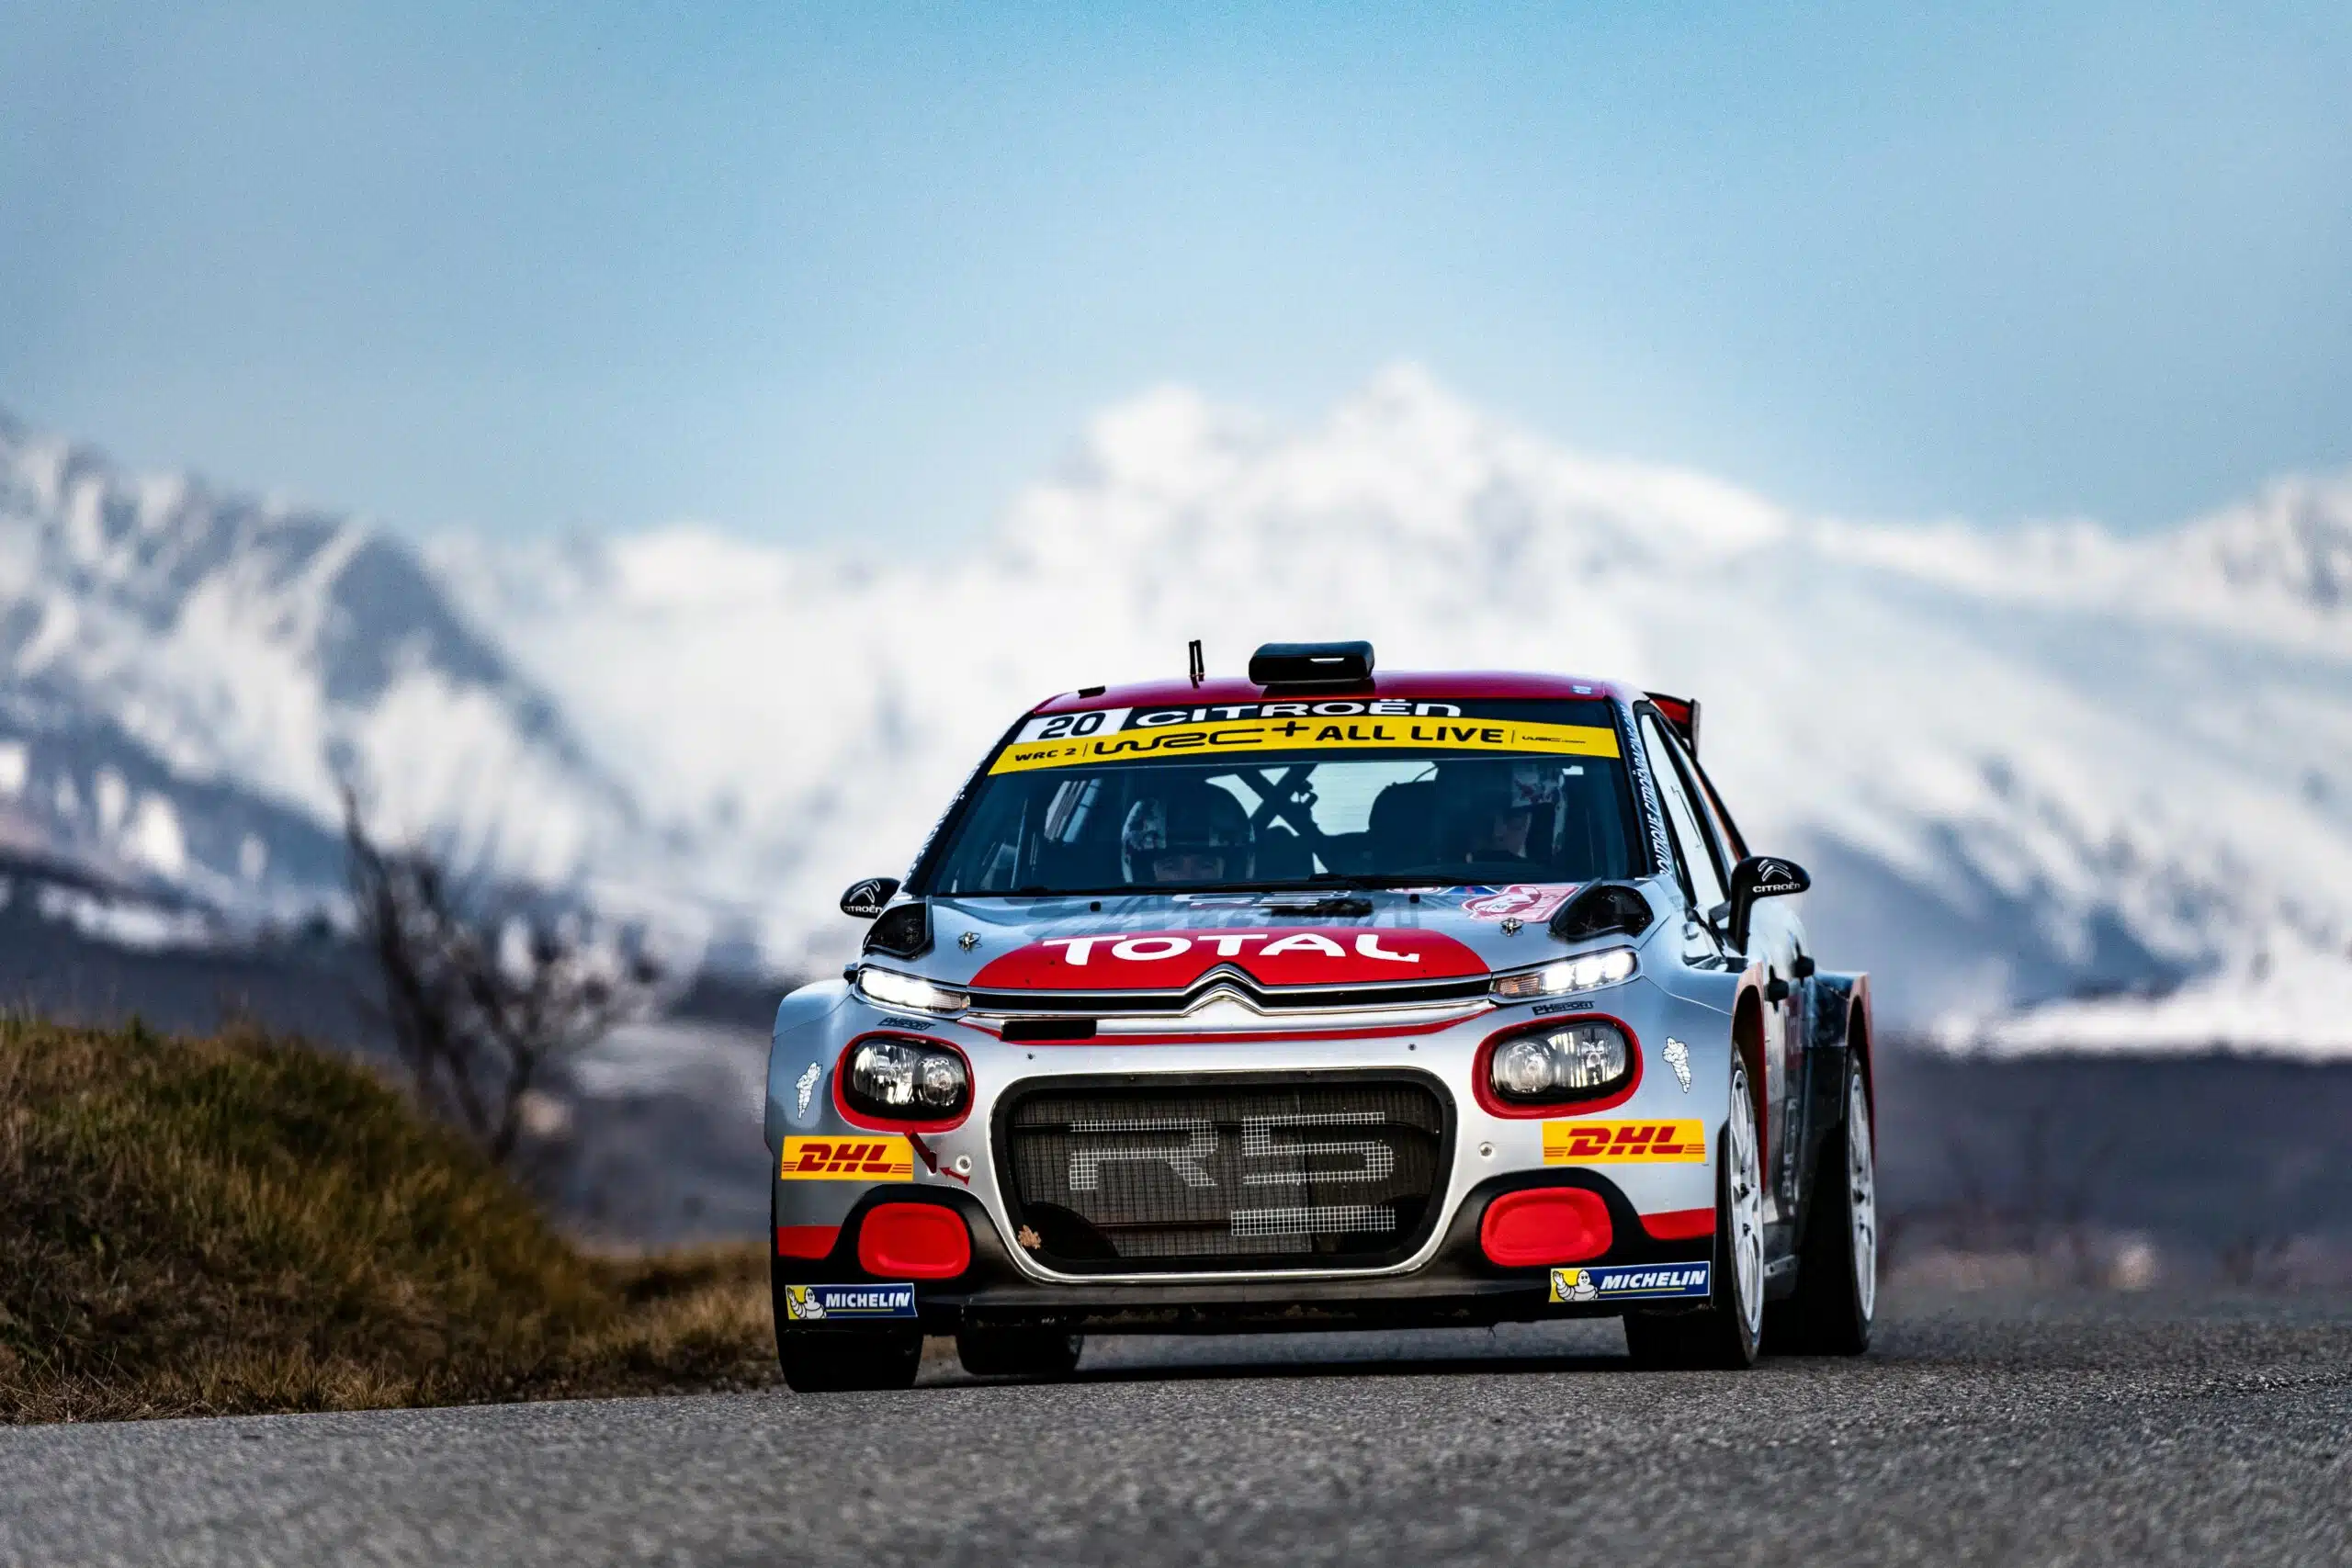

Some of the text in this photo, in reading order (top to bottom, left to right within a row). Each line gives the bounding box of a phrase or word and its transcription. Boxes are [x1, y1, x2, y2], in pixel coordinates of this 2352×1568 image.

[1037, 711, 1107, 740] 20
[1136, 698, 1461, 728] CITROËN
[1014, 750, 1060, 761] WRC
[1064, 747, 1077, 756] 2
[1315, 725, 1396, 742] ALL
[1410, 727, 1504, 744] LIVE
[1752, 881, 1801, 893] CITROËN
[1042, 932, 1420, 966] TOTAL
[1069, 1111, 1396, 1191] R5
[1566, 1125, 1684, 1157] DHL
[796, 1143, 894, 1173] DHL
[1600, 1269, 1707, 1291] MICHELIN
[826, 1292, 910, 1309] MICHELIN
